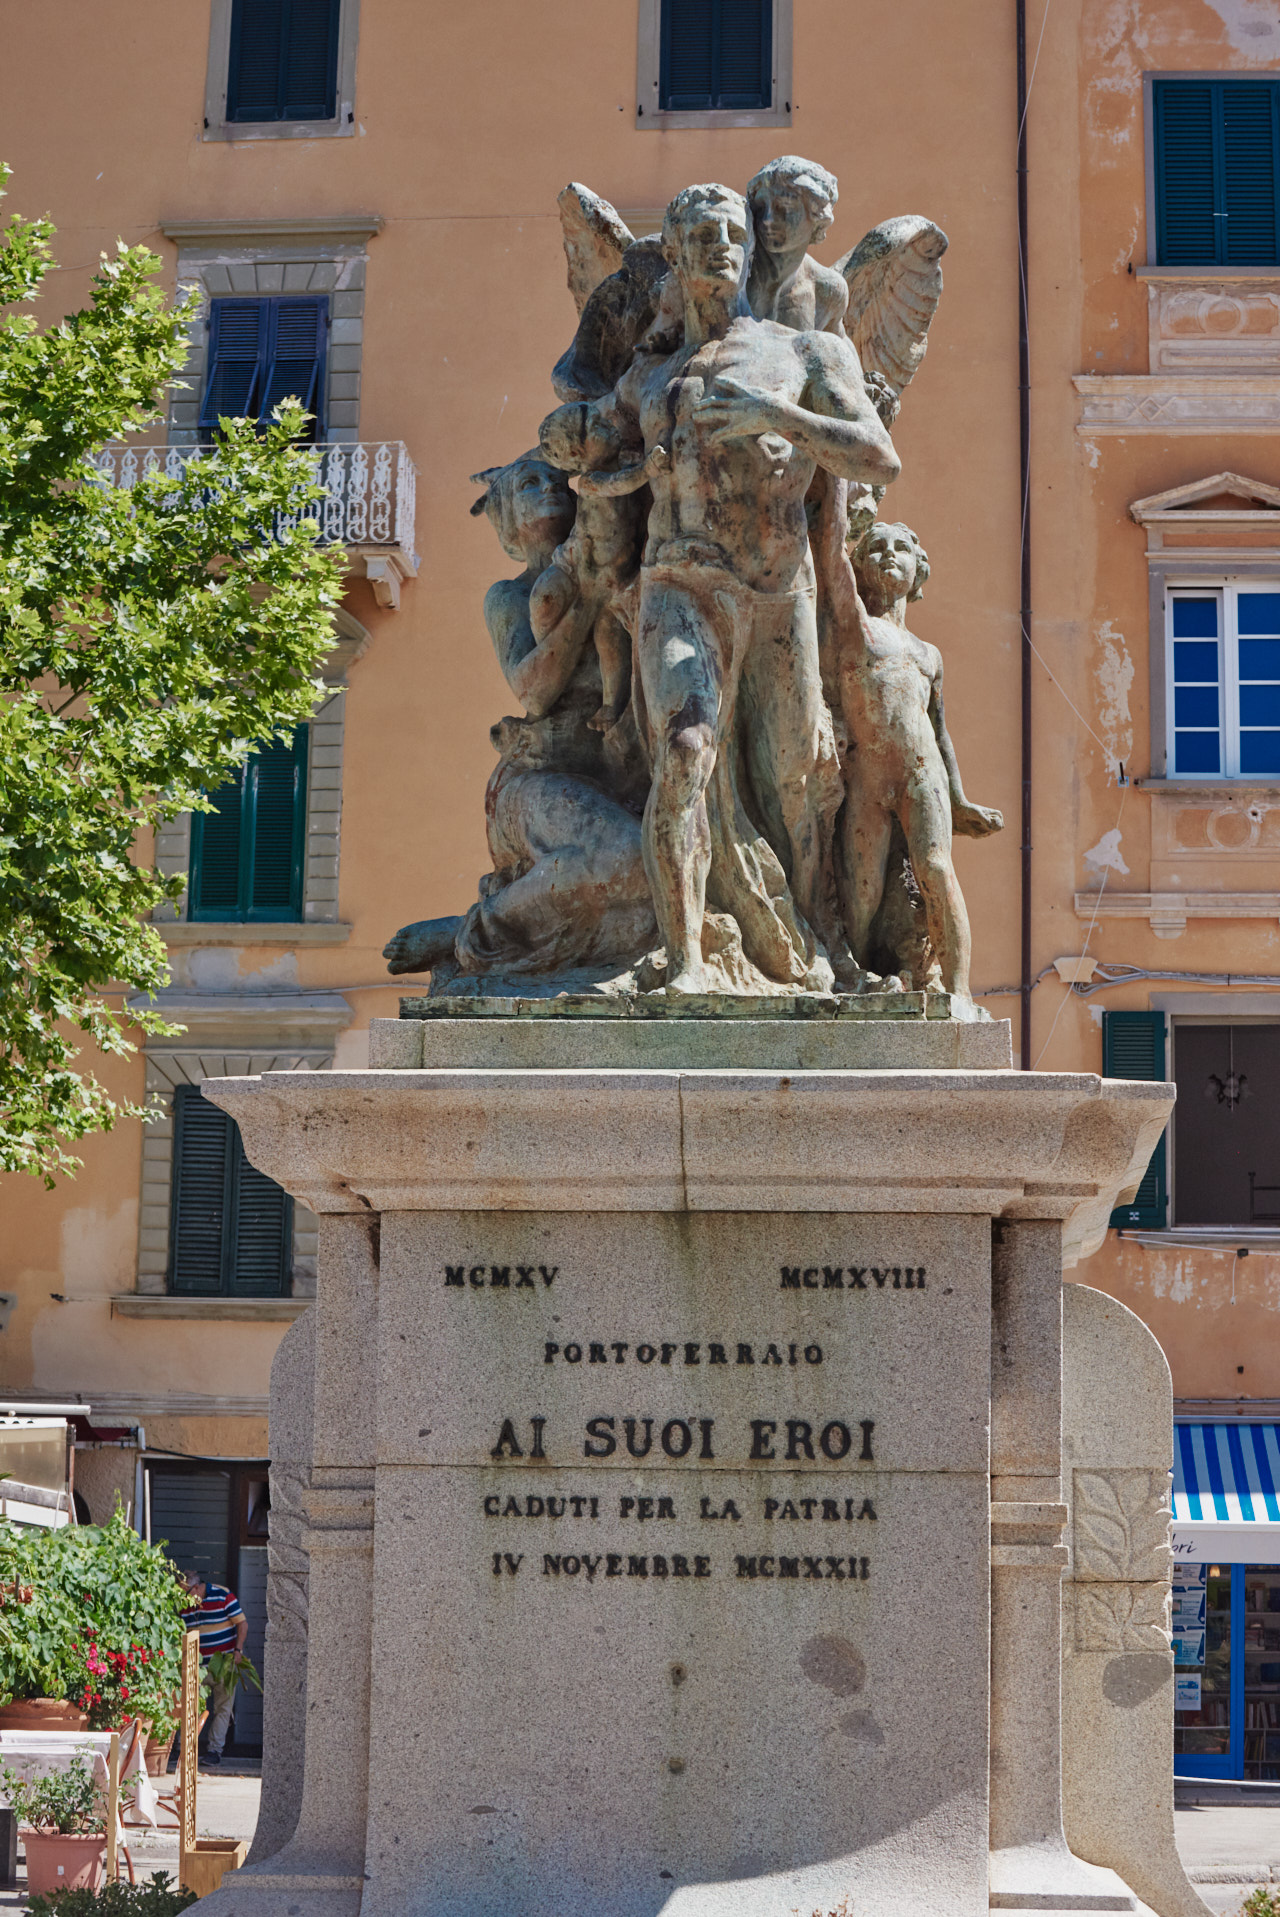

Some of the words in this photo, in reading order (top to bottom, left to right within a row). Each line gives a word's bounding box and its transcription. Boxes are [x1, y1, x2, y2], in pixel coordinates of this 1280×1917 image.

[445, 1265, 559, 1290] MCMXV
[780, 1266, 926, 1290] MCMXVIII
[545, 1342, 824, 1366] PORTOFERRAIO
[491, 1417, 547, 1461] AI
[585, 1417, 715, 1459] SUOI
[750, 1420, 875, 1461] EROI
[484, 1496, 599, 1519] CADUTI
[621, 1497, 676, 1521] PER
[700, 1498, 742, 1521] LA
[764, 1498, 878, 1521] PATRIA
[493, 1554, 524, 1576] IV
[544, 1554, 711, 1580] NOVEMBRE
[735, 1556, 869, 1580] MCMXXII
